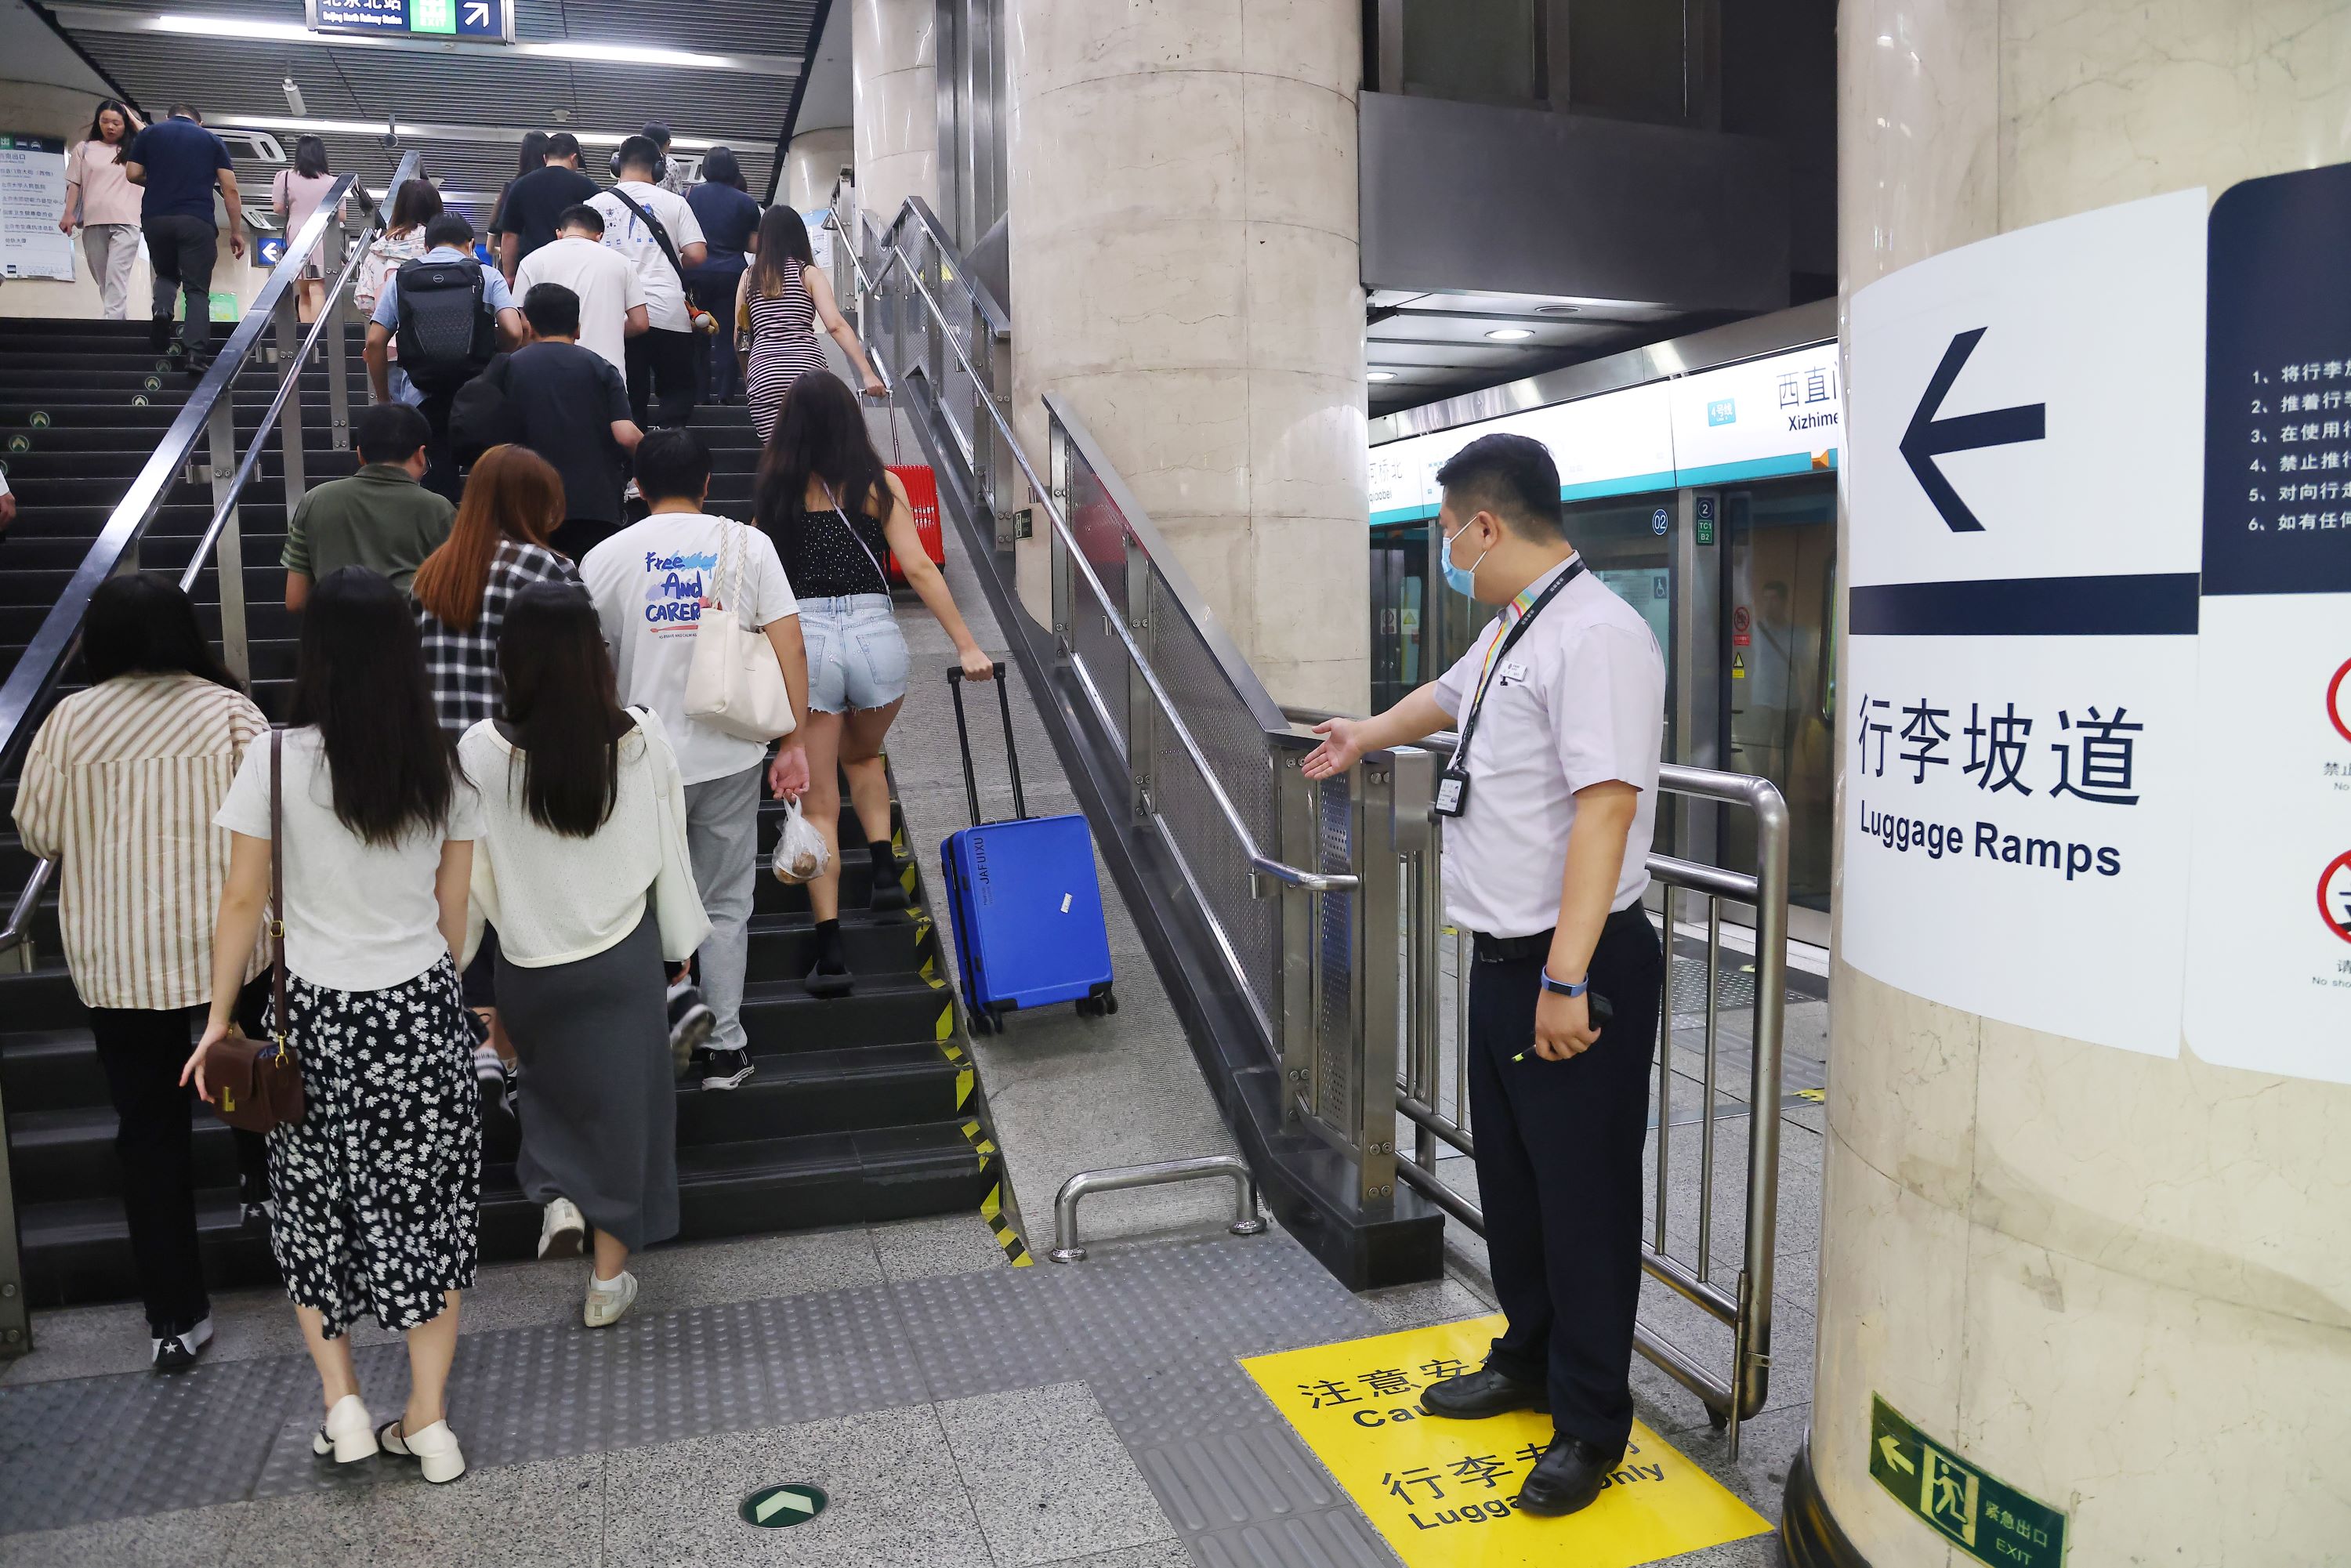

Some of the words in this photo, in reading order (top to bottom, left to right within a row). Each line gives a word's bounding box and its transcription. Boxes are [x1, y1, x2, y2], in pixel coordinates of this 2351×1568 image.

[419, 17, 446, 27] EXIT
[1711, 402, 1733, 418] 4号线
[1702, 504, 1708, 514] 2
[1654, 514, 1666, 530] 02
[645, 551, 686, 573] Free
[661, 570, 703, 599] And
[1858, 693, 2144, 806] 行李坡道
[2333, 782, 2349, 791] No
[1860, 799, 1964, 860] Luggage
[1974, 820, 2121, 881] Ramps
[973, 837, 990, 885] JAFUIXU
[2312, 976, 2327, 986] No
[1296, 1349, 1492, 1410] 注意安
[1984, 1499, 2048, 1548] 紧急出口
[1996, 1537, 2034, 1566] EXIT
